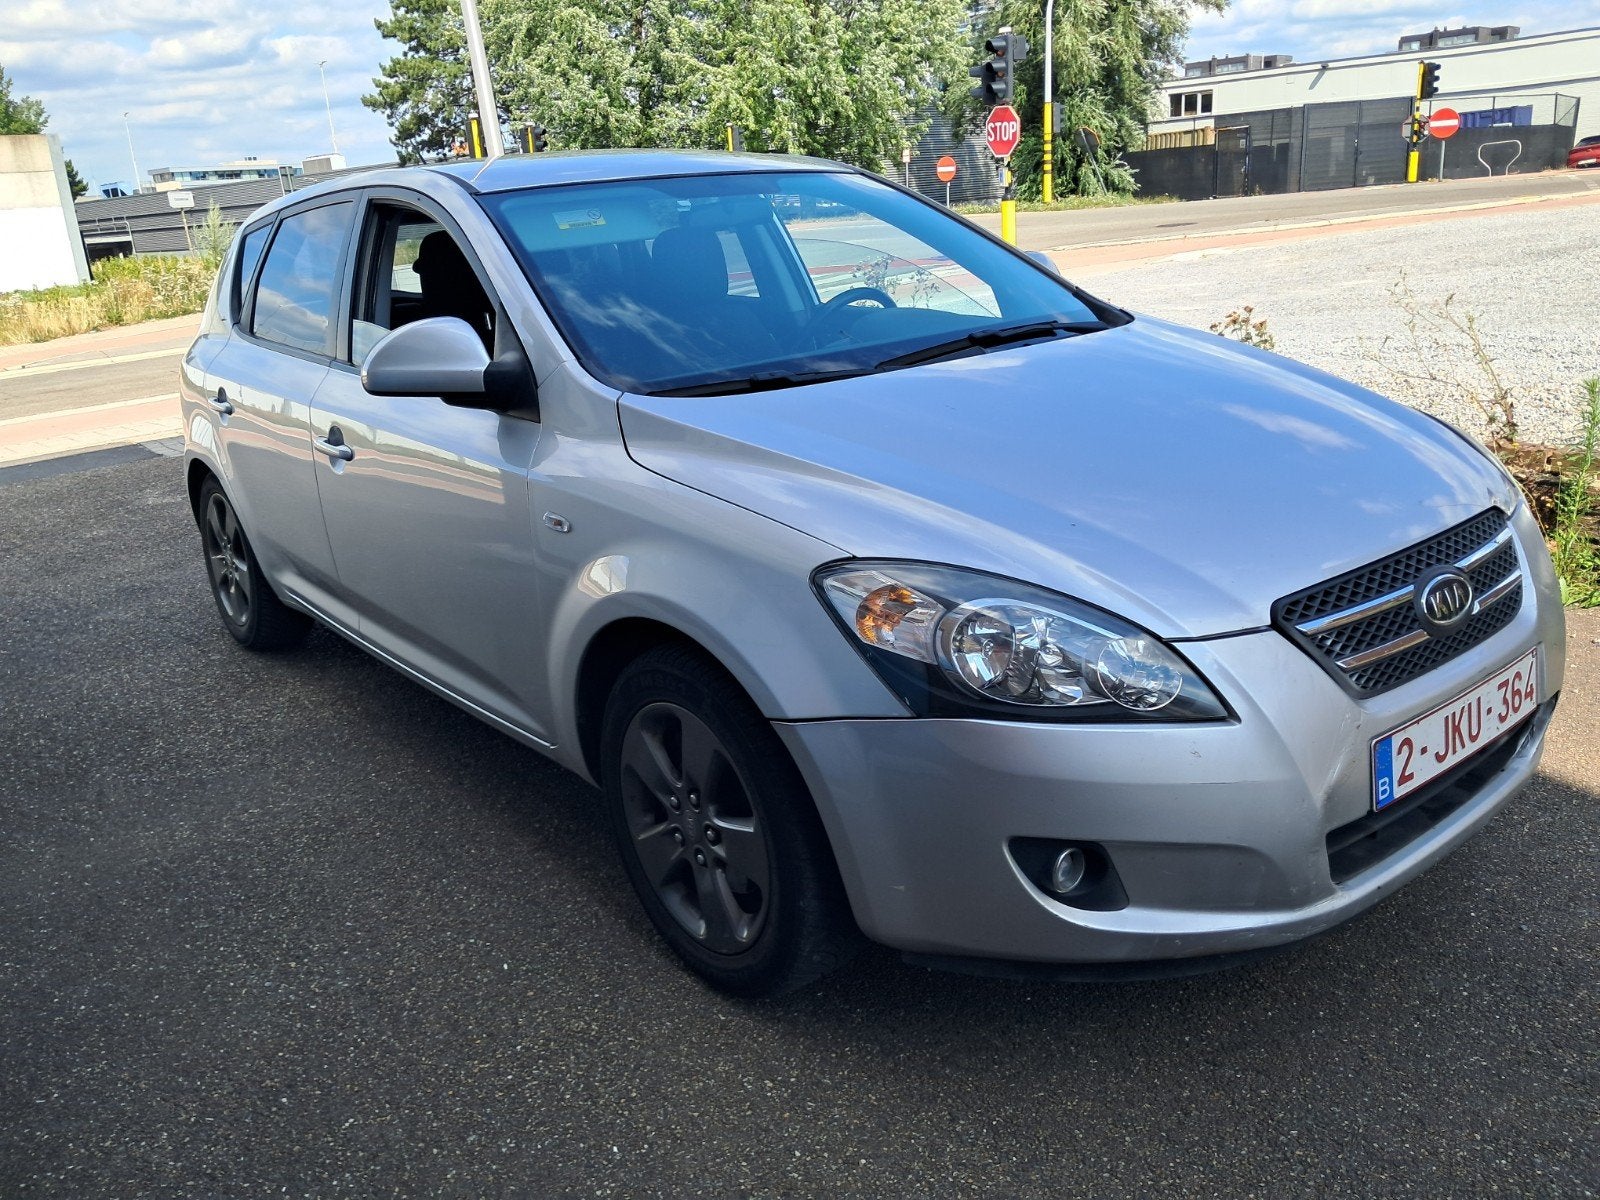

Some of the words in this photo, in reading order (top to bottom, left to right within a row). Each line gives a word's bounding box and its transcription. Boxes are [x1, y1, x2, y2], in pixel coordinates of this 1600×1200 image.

[987, 121, 1017, 141] STOP
[1430, 583, 1467, 618] KIA
[1396, 660, 1535, 787] 2-JKU-364
[1377, 777, 1391, 800] B
